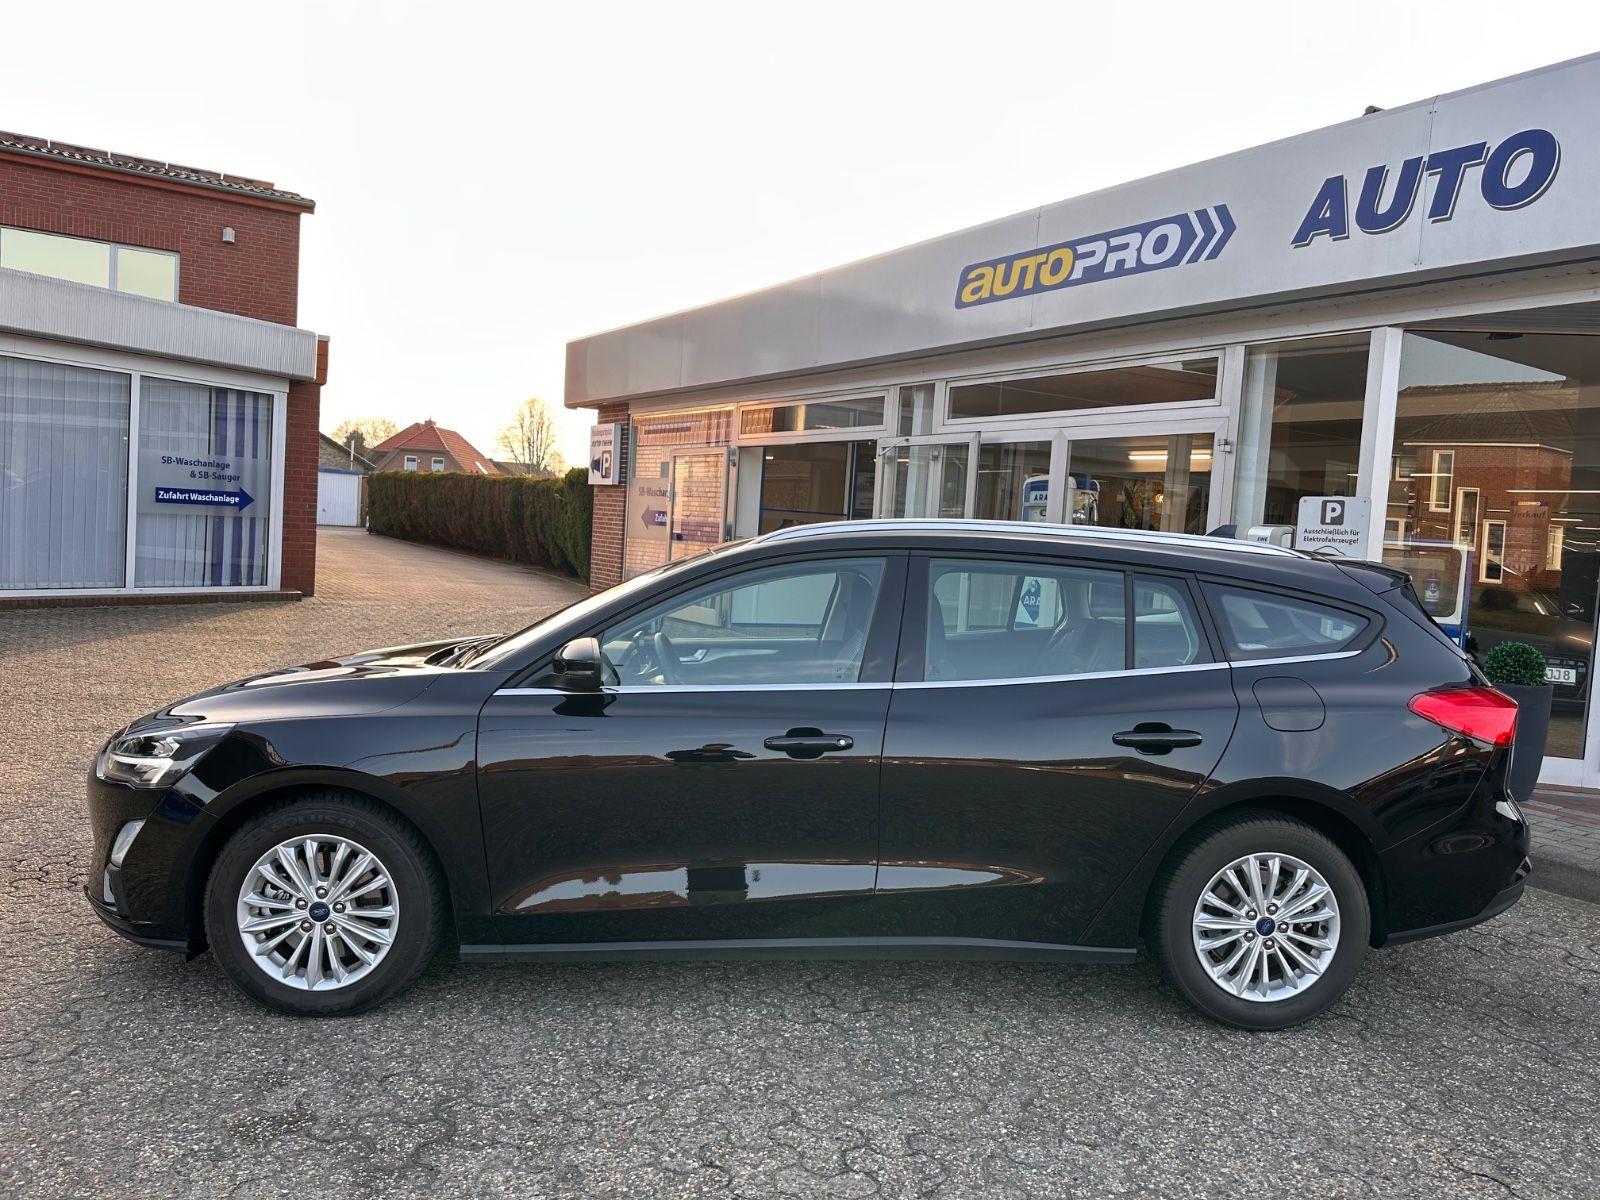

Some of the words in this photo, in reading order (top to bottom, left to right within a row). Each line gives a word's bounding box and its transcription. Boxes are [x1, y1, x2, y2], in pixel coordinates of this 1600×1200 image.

[1291, 129, 1561, 248] AUTO
[161, 455, 231, 470] SB-Waschanlage
[190, 470, 197, 478] &
[198, 470, 240, 482] SB-Sauger
[158, 491, 189, 500] Zufahrt
[190, 492, 240, 504] Waschanlage
[1303, 528, 1348, 536] Ausschließlich
[1303, 536, 1359, 545] Elektrofahrzeuge!
